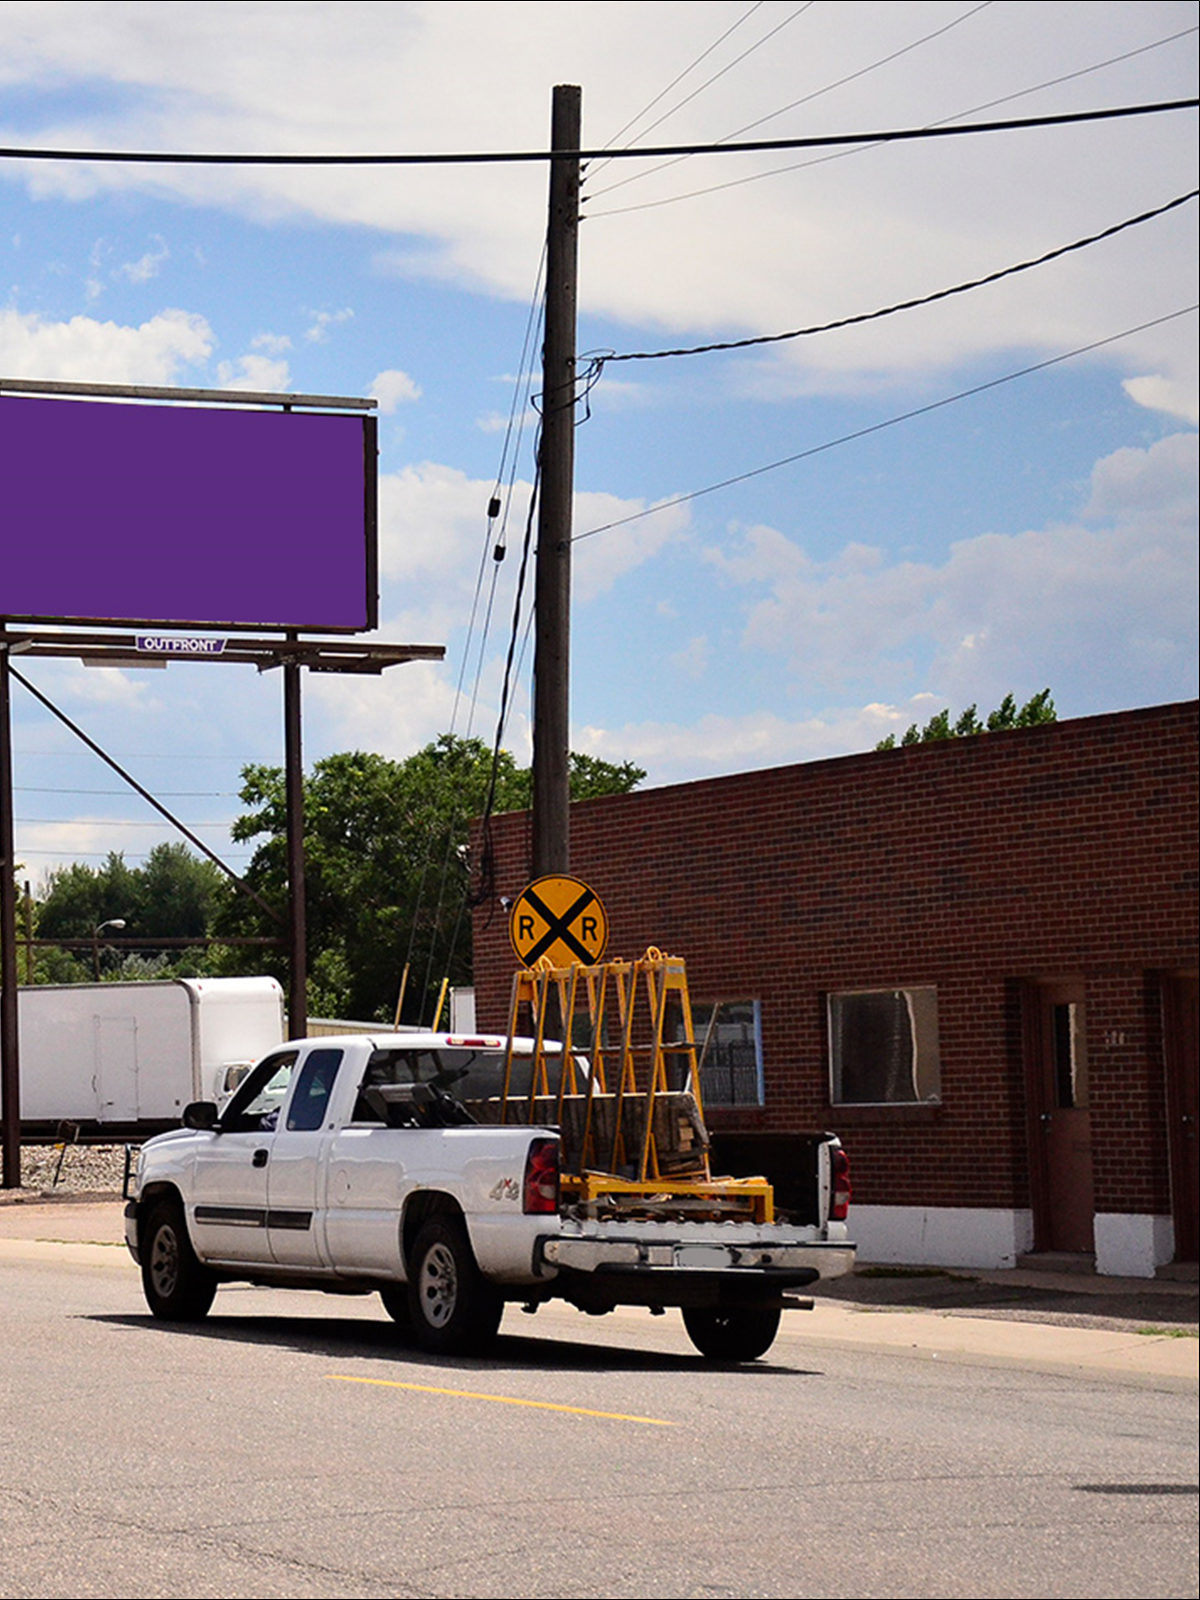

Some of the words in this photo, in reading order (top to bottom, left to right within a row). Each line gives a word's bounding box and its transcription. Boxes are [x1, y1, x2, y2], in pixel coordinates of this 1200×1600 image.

[144, 638, 217, 651] OUTFRONT
[519, 916, 534, 940] R
[582, 917, 597, 941] R
